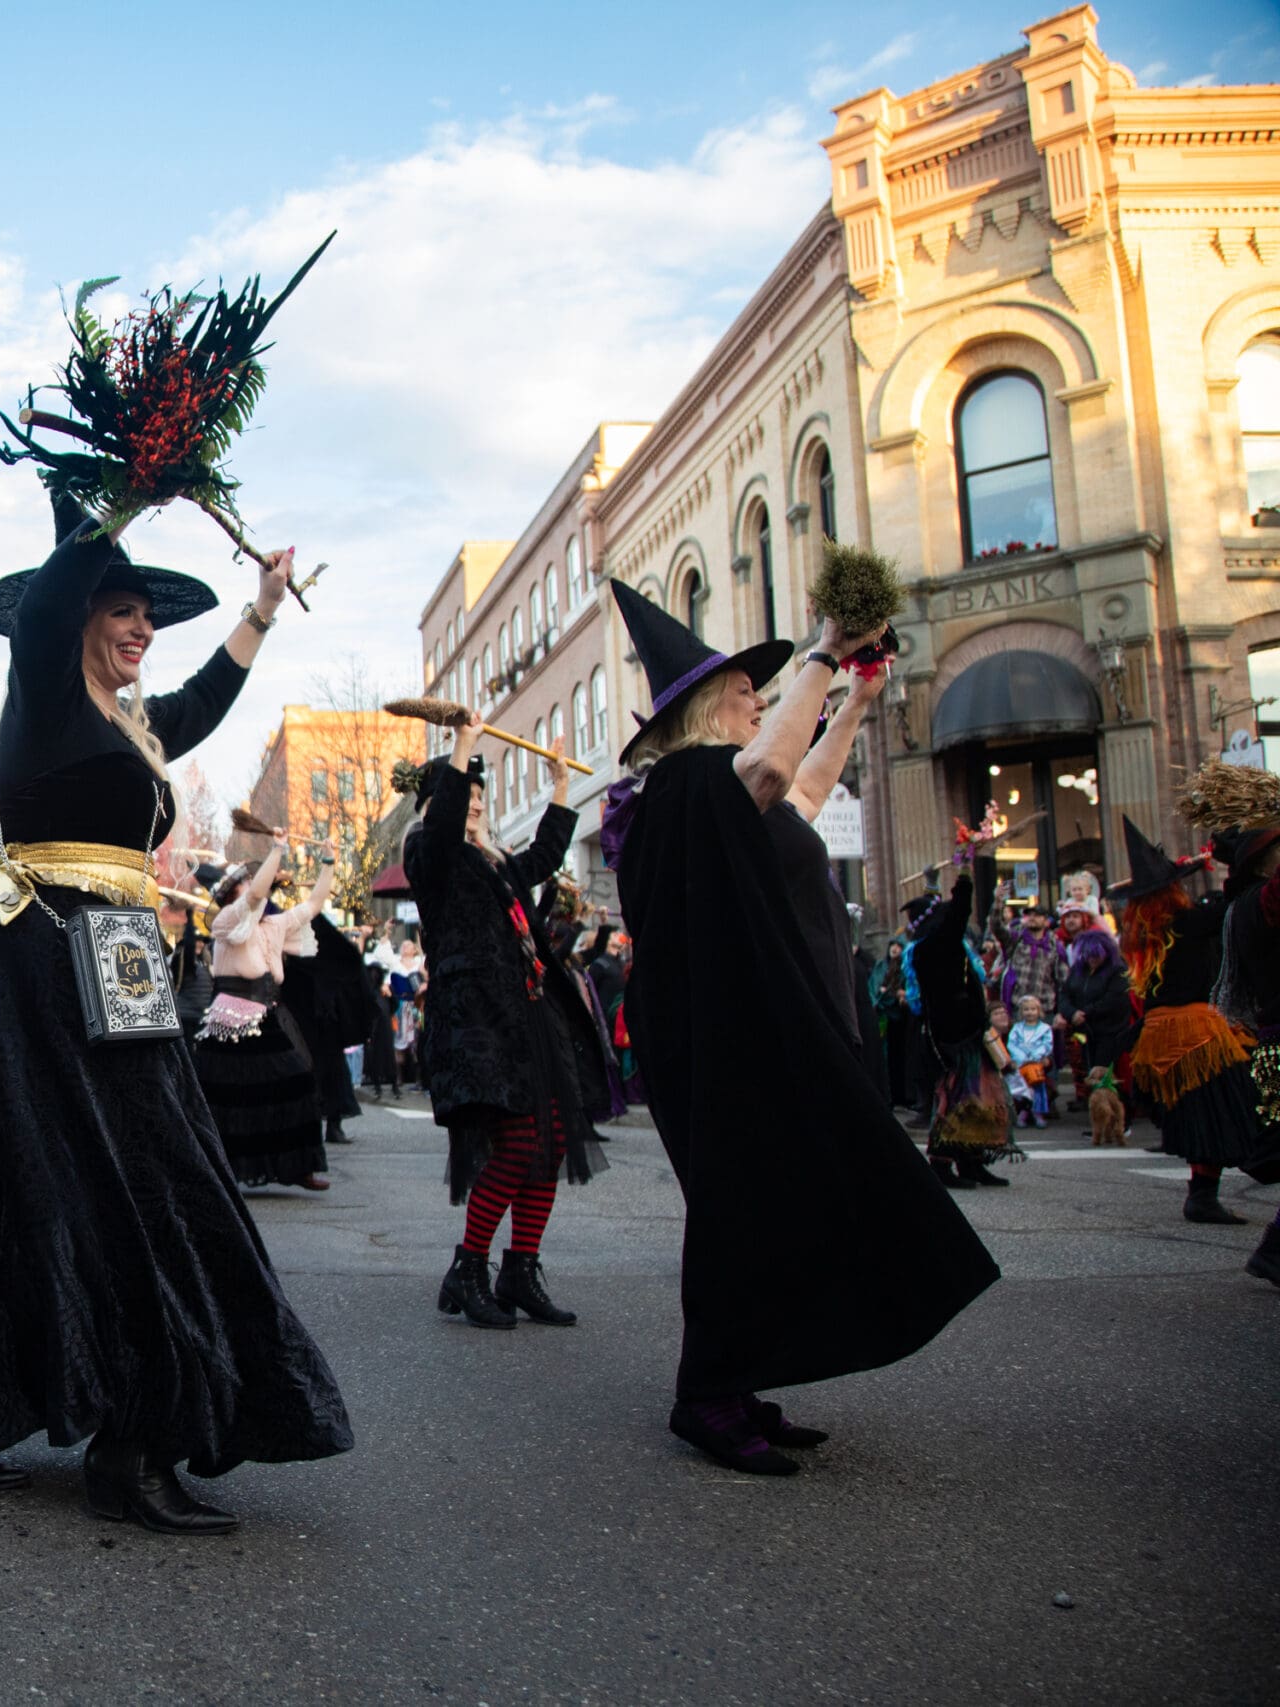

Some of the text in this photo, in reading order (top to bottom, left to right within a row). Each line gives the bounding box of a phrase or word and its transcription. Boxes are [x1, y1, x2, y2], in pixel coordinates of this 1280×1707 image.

[915, 69, 1007, 118] 1900
[949, 572, 1055, 615] BANK
[821, 811, 857, 821] THREE
[111, 943, 147, 964] Book
[126, 962, 139, 976] of
[118, 977, 155, 999] Spells
